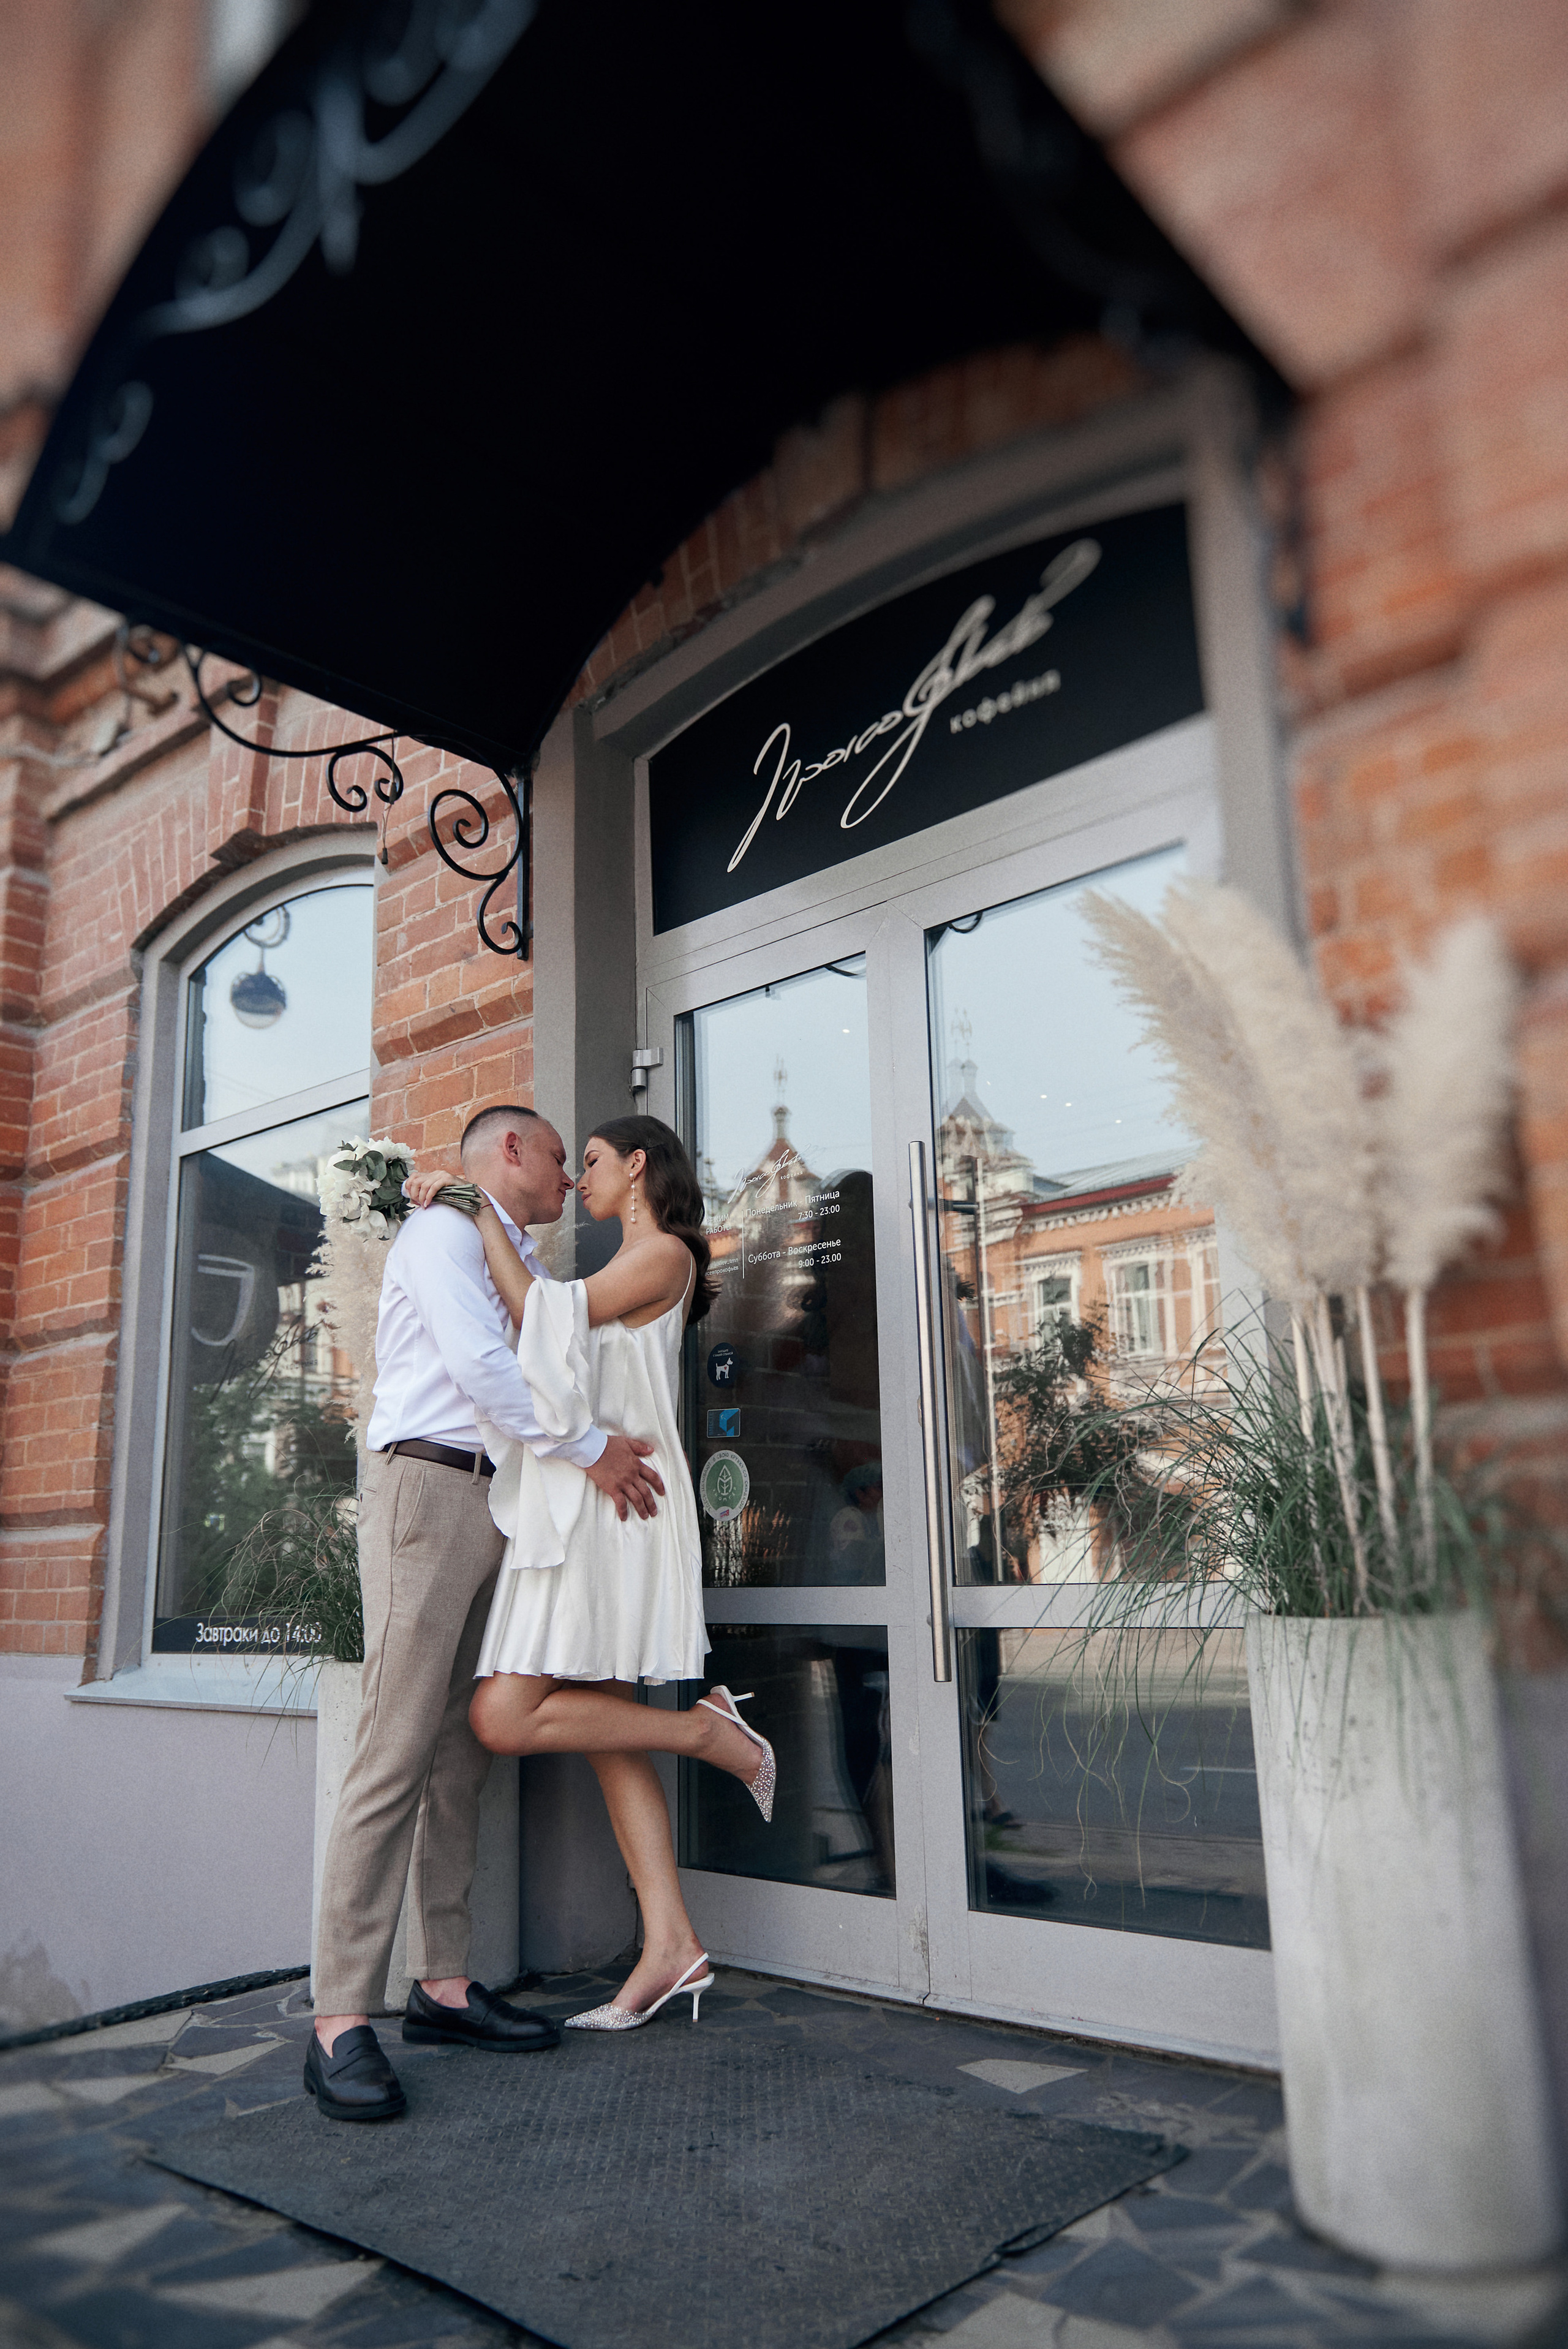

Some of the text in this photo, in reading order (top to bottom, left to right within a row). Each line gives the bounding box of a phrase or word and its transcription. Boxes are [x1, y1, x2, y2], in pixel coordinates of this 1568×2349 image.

[780, 1171, 803, 1180] кофейня
[745, 1200, 797, 1217] Понедельник
[805, 1190, 840, 1204] Пятница
[706, 1214, 729, 1224] РЕЖИМ
[798, 1210, 813, 1220] 7:30
[820, 1204, 840, 1216] 23:00
[706, 1223, 732, 1235] РАБОТЫ
[748, 1251, 781, 1265] Суббота
[788, 1239, 842, 1255] Воскресенье
[798, 1258, 814, 1268] 9:00
[821, 1252, 842, 1264] 23.00
[195, 1622, 259, 1646] Завтраки
[261, 1627, 281, 1644] до
